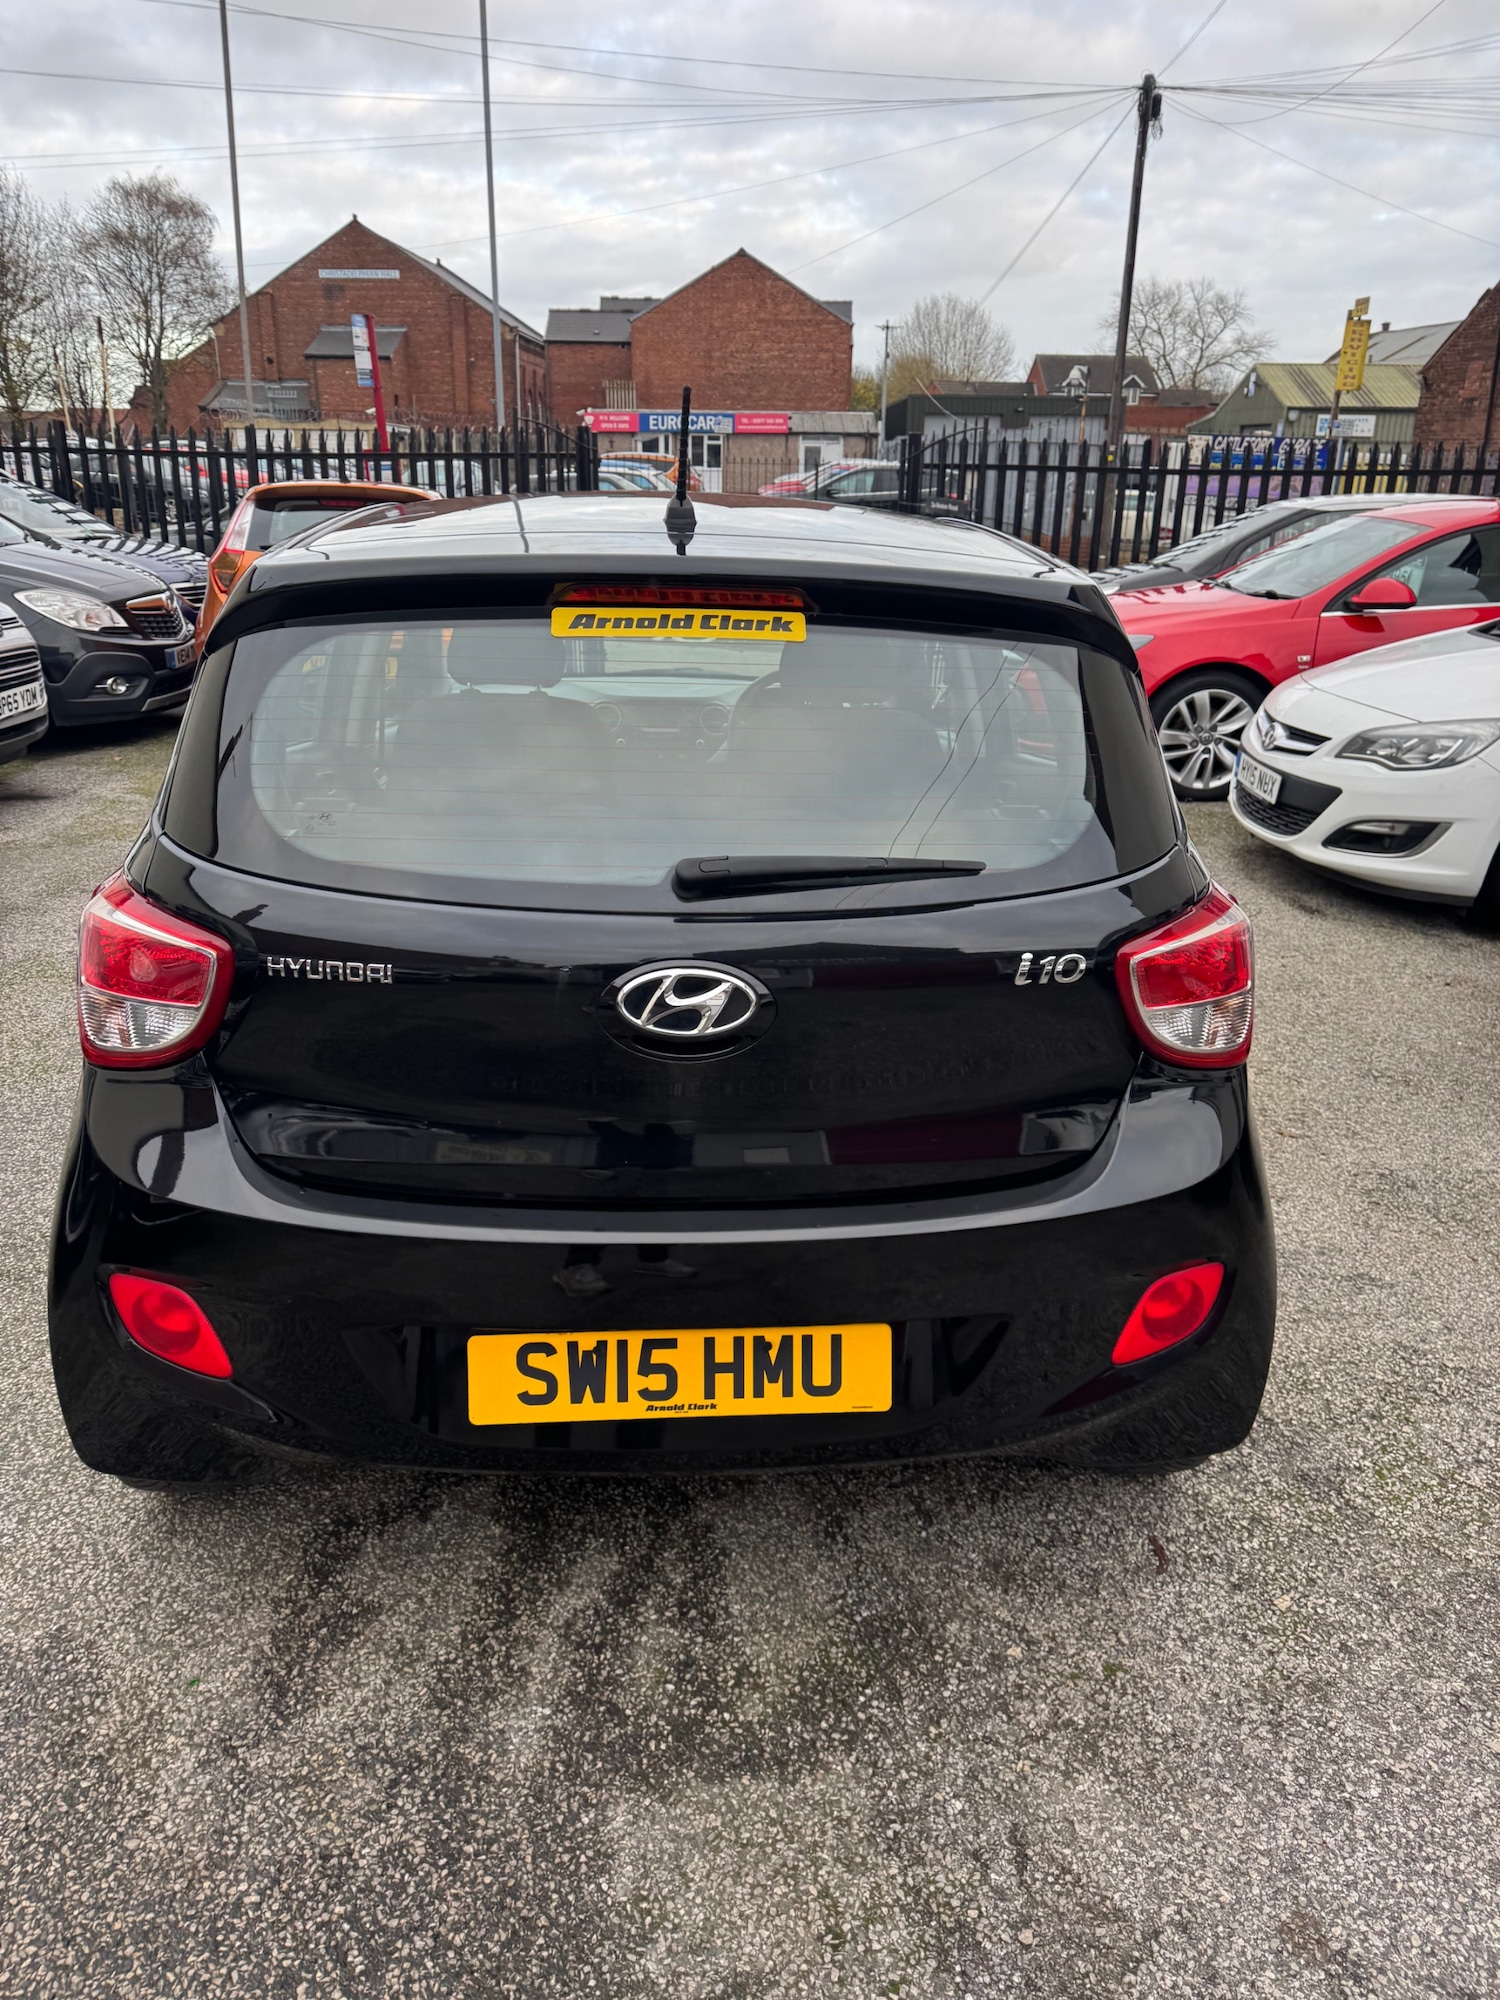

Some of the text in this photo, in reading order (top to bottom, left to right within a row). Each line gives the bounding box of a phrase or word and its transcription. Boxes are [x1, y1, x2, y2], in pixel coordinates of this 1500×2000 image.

[649, 415, 721, 430] EURCAR
[1279, 437, 1327, 454] GRAE
[568, 613, 794, 632] Arnold Clark
[0, 686, 38, 716] P65 YDM
[266, 956, 393, 985] HYUNDAI
[1014, 952, 1087, 986] i10
[515, 1333, 842, 1406] SW15 HMU
[645, 1404, 685, 1412] Arnold
[687, 1403, 717, 1411] Clark
